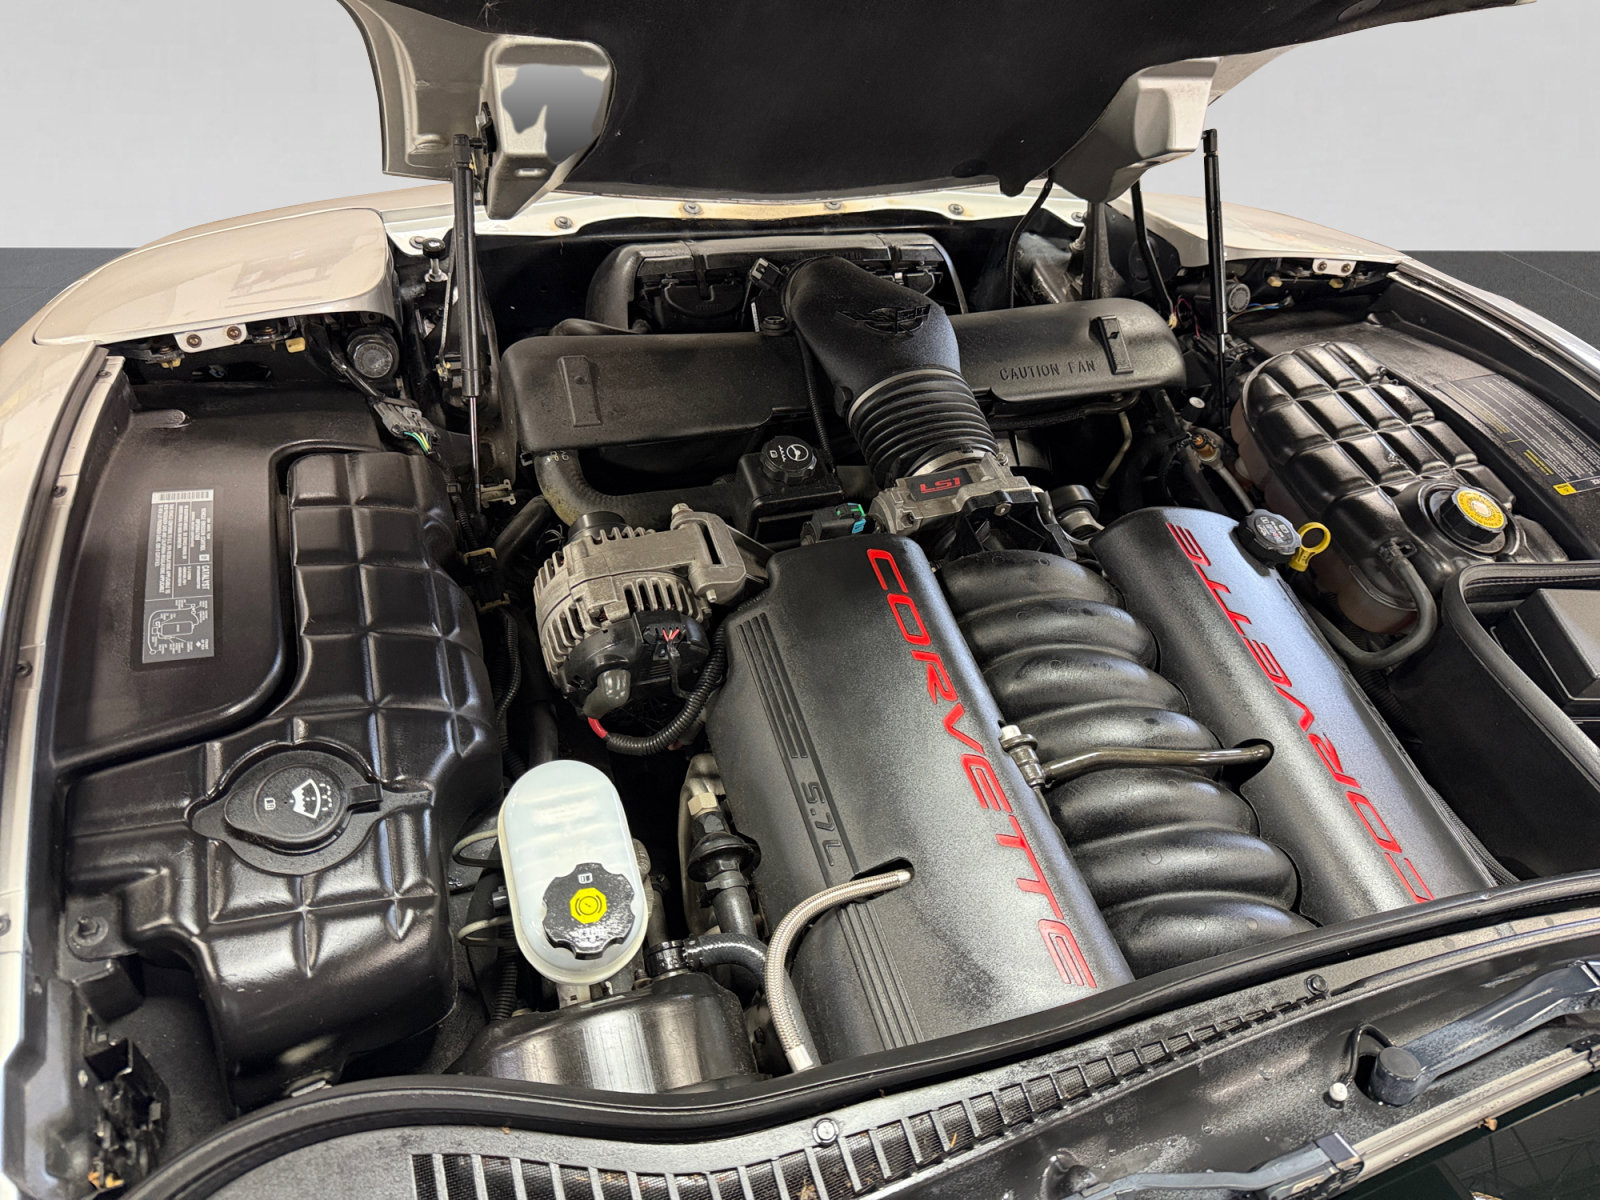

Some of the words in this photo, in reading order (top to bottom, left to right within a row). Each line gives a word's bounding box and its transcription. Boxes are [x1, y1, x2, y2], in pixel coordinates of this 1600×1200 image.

[999, 363, 1061, 381] CAUTION
[1067, 359, 1097, 374] FAN
[919, 476, 961, 494] LS1
[201, 564, 210, 590] CATALYST
[1167, 522, 1435, 904] CORVETTE
[866, 548, 1097, 989] CORVETTE
[800, 781, 841, 866] 5.7L
